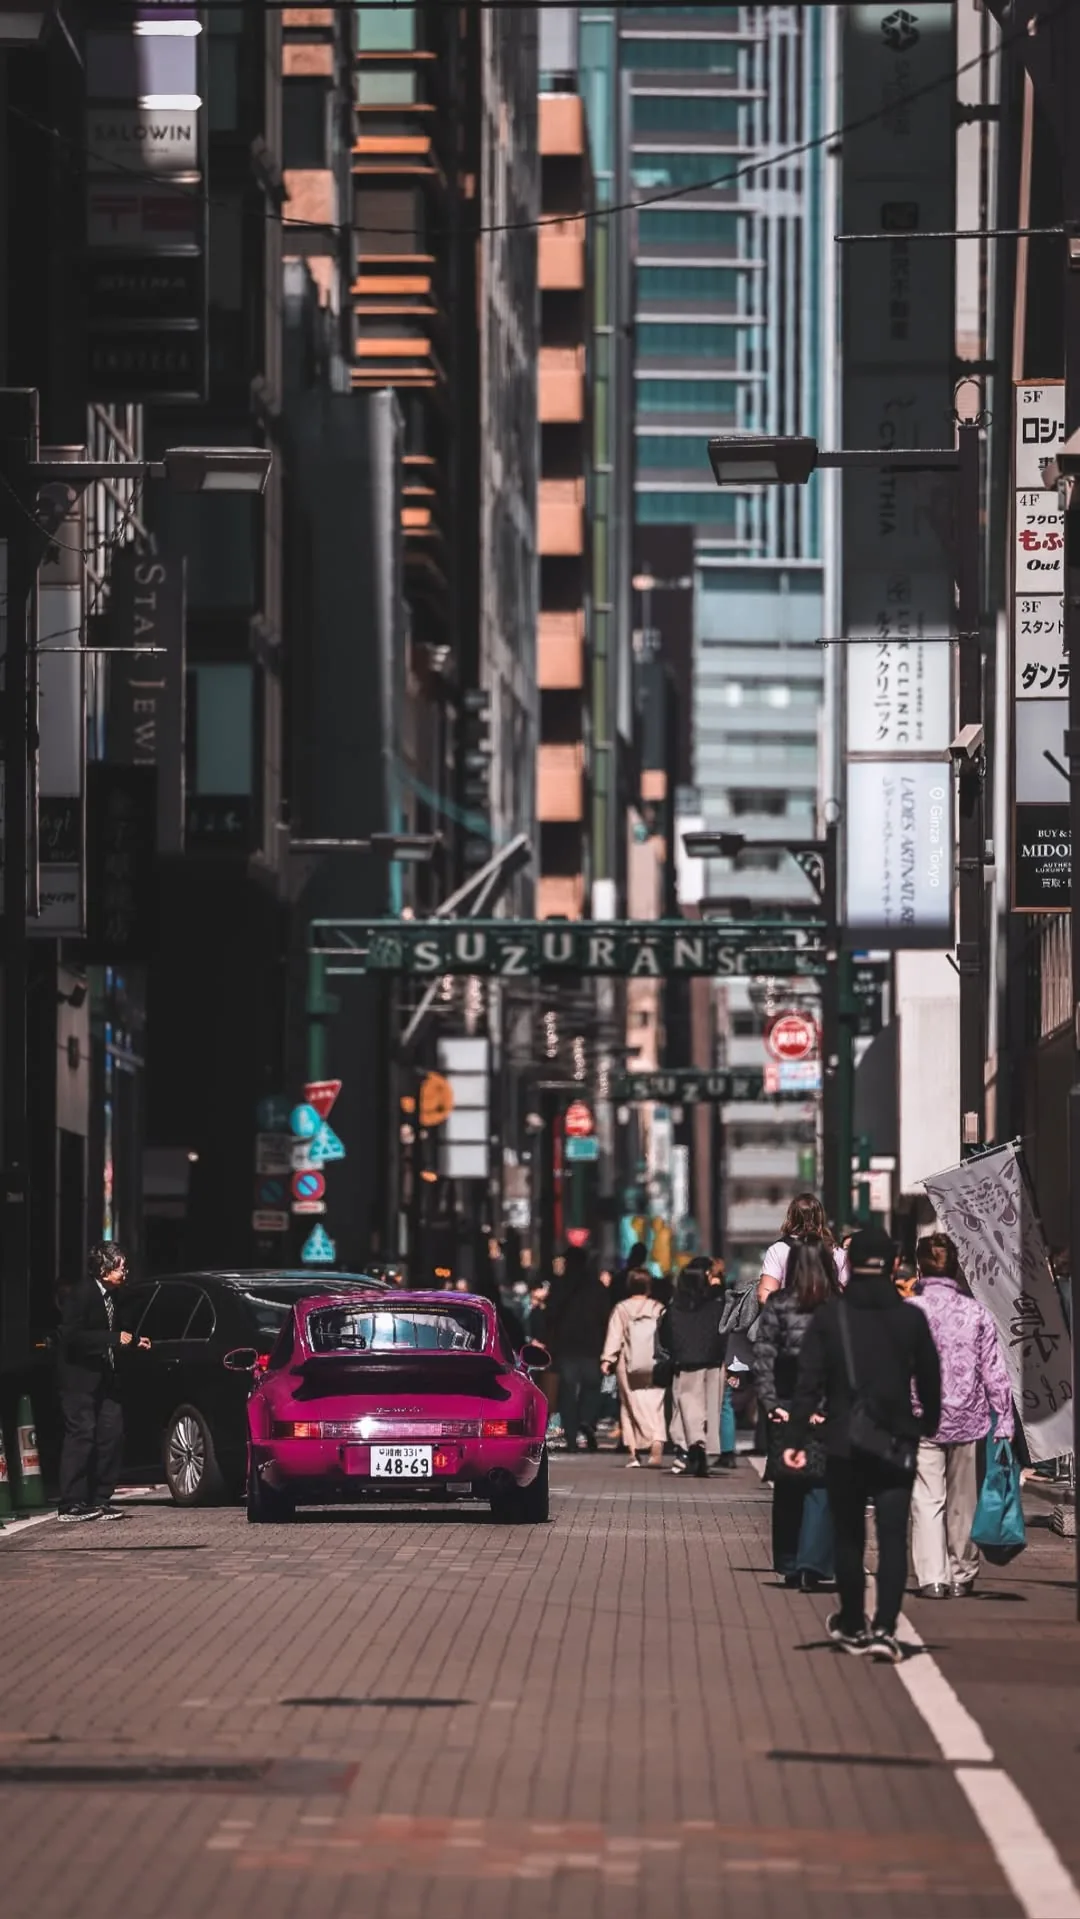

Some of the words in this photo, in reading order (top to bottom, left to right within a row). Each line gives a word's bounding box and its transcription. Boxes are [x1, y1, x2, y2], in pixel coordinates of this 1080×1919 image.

[1023, 391, 1043, 403] 5F
[879, 422, 896, 534] CYTHIA
[1019, 494, 1040, 506] 4F
[1018, 530, 1064, 551] もふ
[1026, 559, 1060, 571] Owl
[1021, 601, 1041, 613] 3F
[897, 661, 910, 744] CLINIC
[413, 931, 704, 976] SUZURAN
[384, 1458, 429, 1474] 48-69
